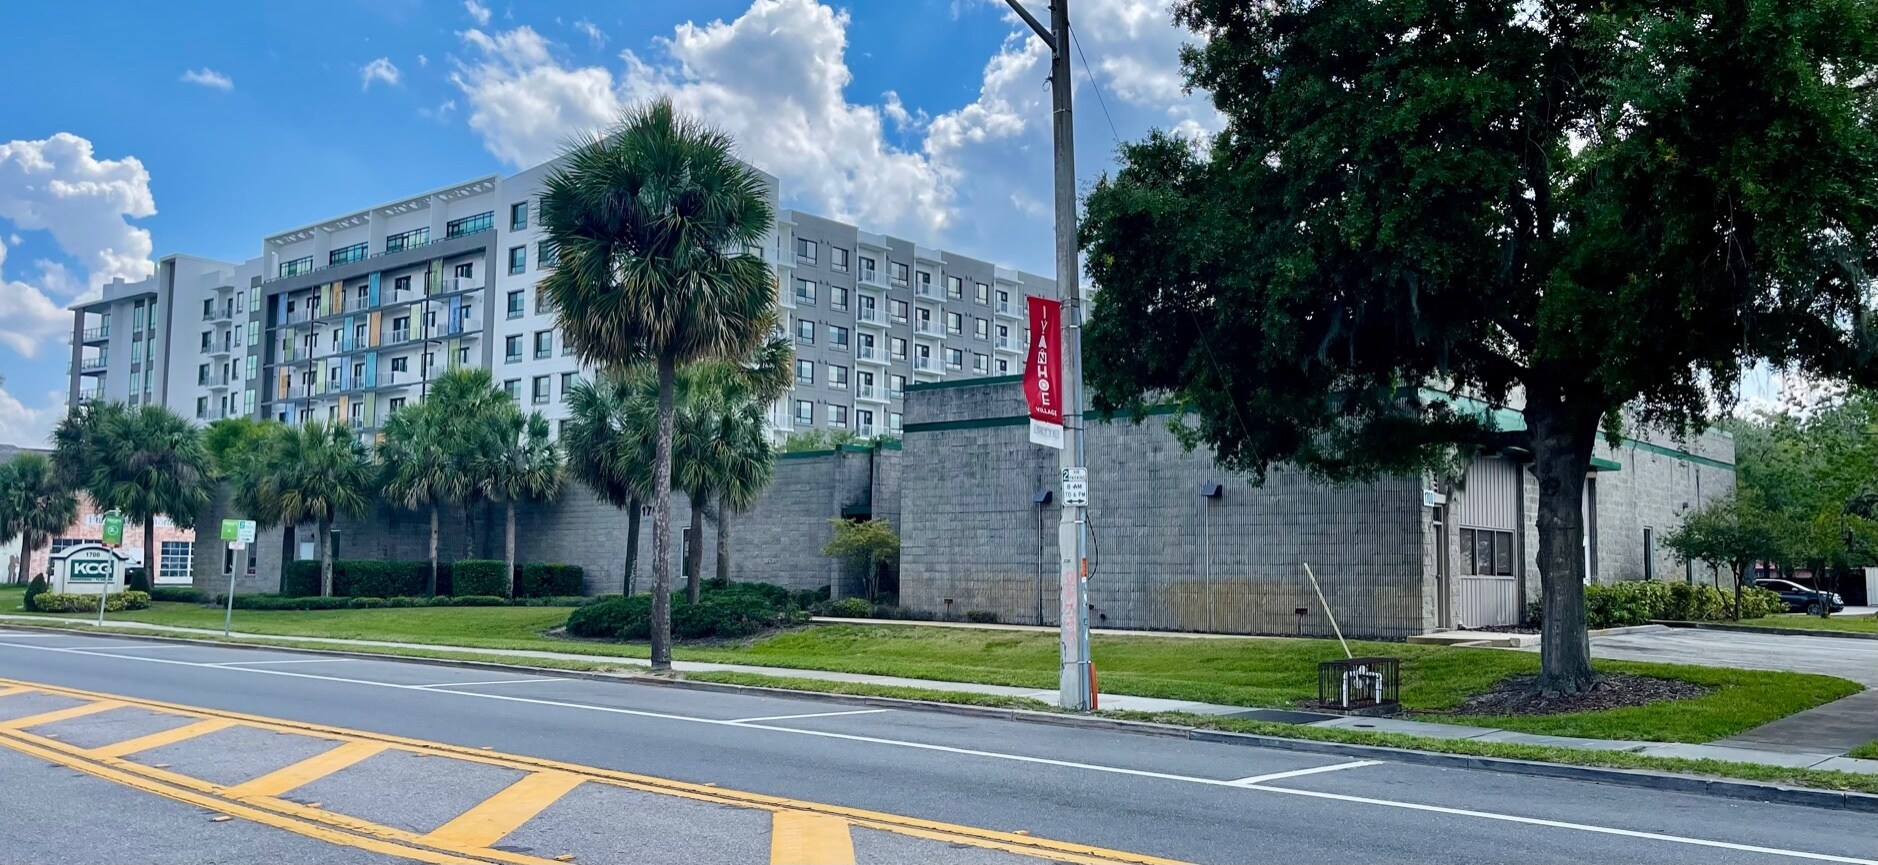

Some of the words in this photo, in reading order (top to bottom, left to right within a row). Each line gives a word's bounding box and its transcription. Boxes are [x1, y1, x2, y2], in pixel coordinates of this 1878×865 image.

[1037, 305, 1050, 406] IVANHOE
[1035, 406, 1057, 417] VILLAGE
[1063, 470, 1069, 480] 2
[74, 562, 113, 575] KCG
